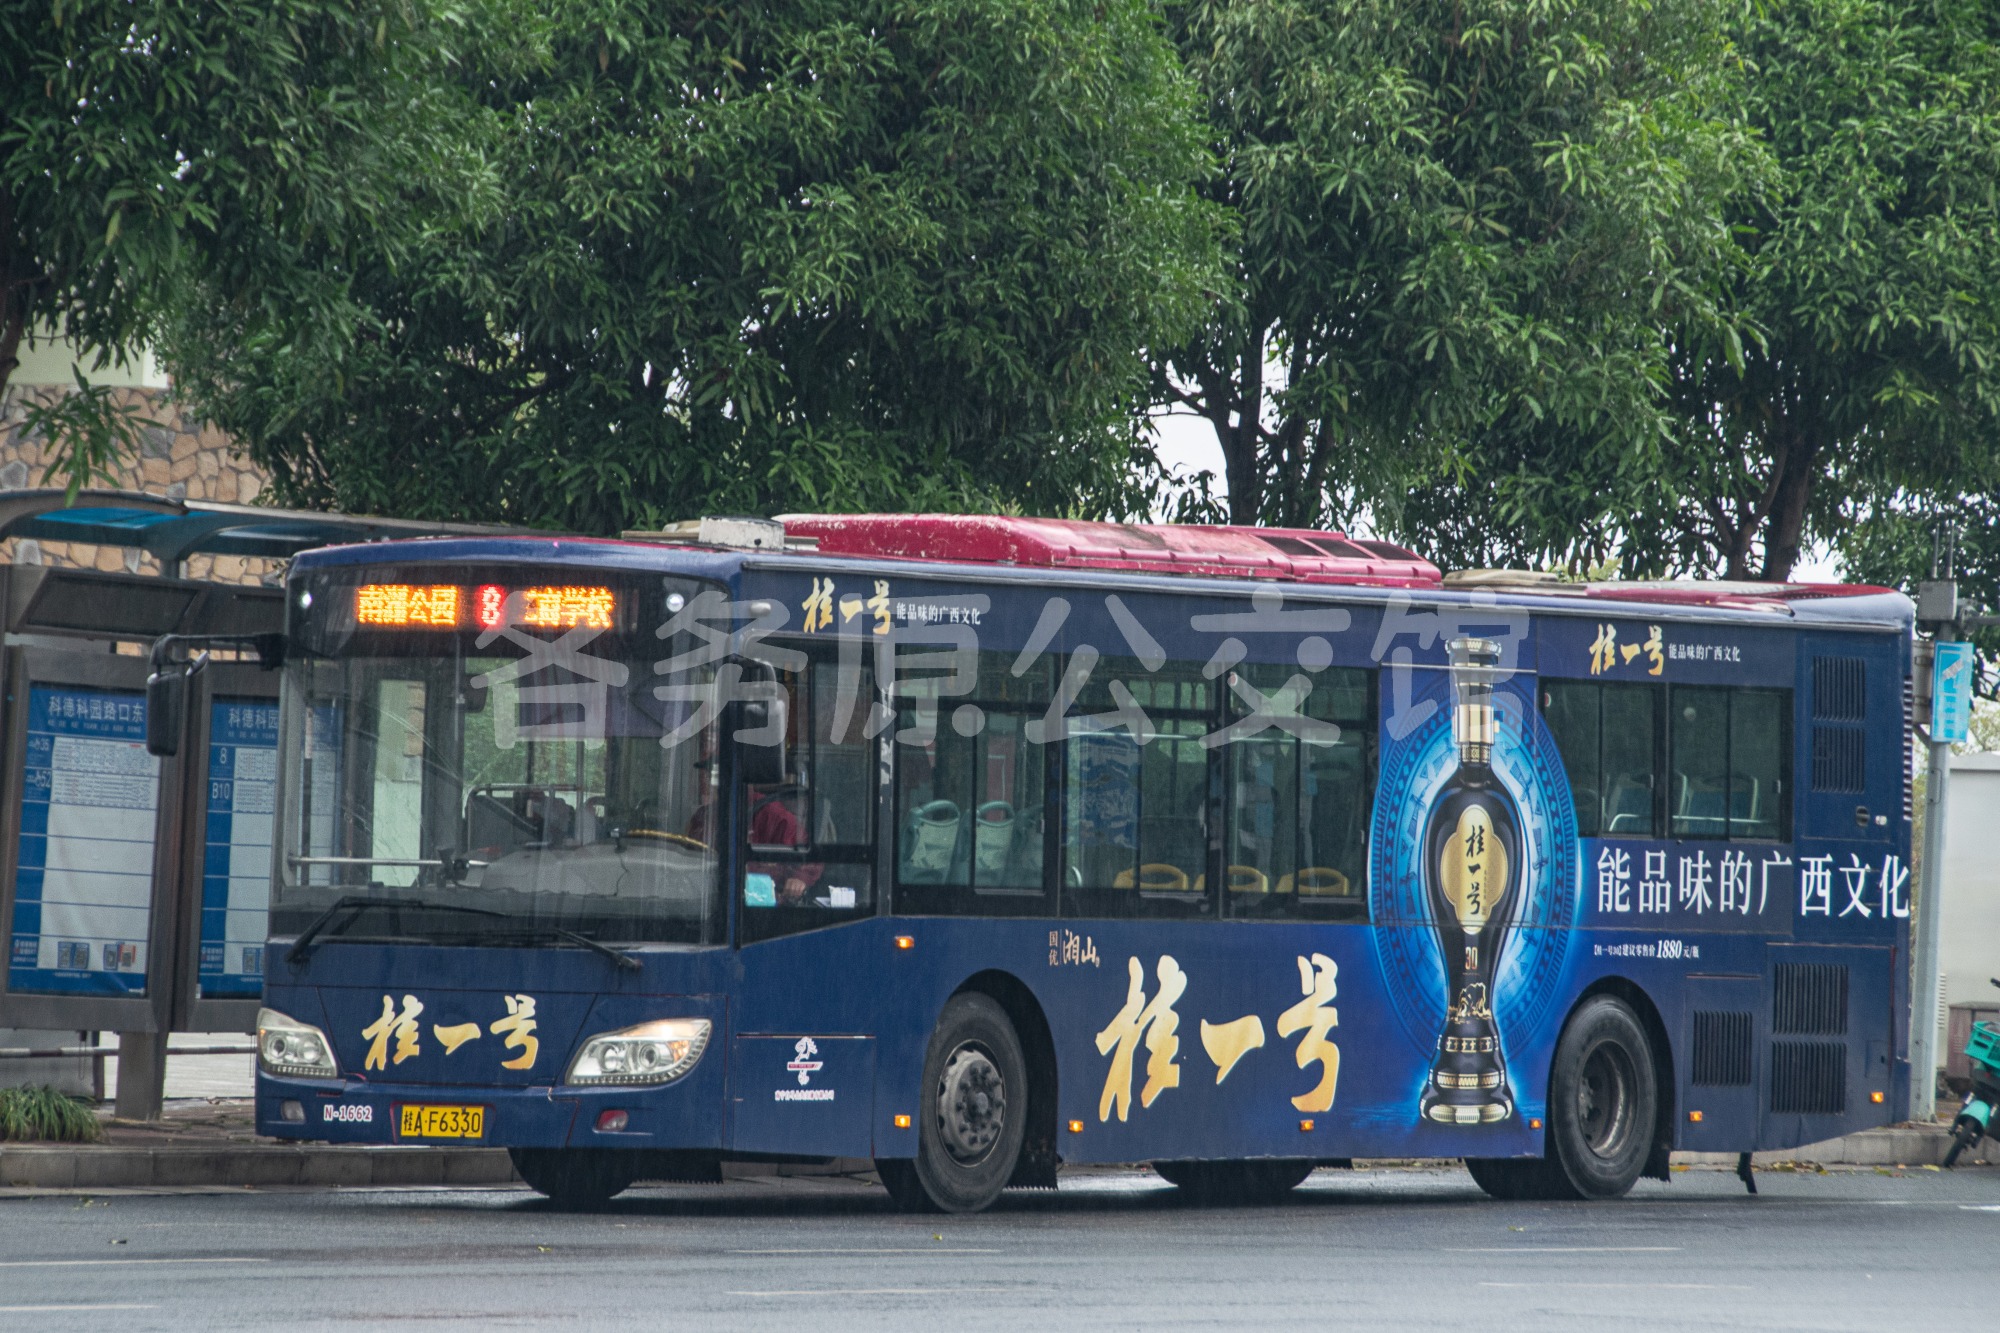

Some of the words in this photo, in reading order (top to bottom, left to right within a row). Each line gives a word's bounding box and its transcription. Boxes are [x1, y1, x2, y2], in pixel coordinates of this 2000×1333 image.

[358, 585, 457, 625] 南湖公园
[481, 586, 501, 625] 8
[802, 577, 890, 635] 桂一号
[896, 602, 981, 625] 能品味的广西文化
[1589, 623, 1664, 675] 桂一号
[1668, 643, 1741, 662] 能品味的广西文化
[48, 695, 144, 723] 科德科园路口东
[219, 747, 228, 764] 8
[212, 782, 230, 799] B10
[1465, 825, 1485, 915] 桂一号
[1596, 846, 1910, 918] 能品味的广西文化
[1465, 946, 1479, 970] 30
[361, 993, 539, 1071] 桂一号
[1095, 952, 1340, 1122] 桂一号
[323, 1104, 373, 1122] N-1662
